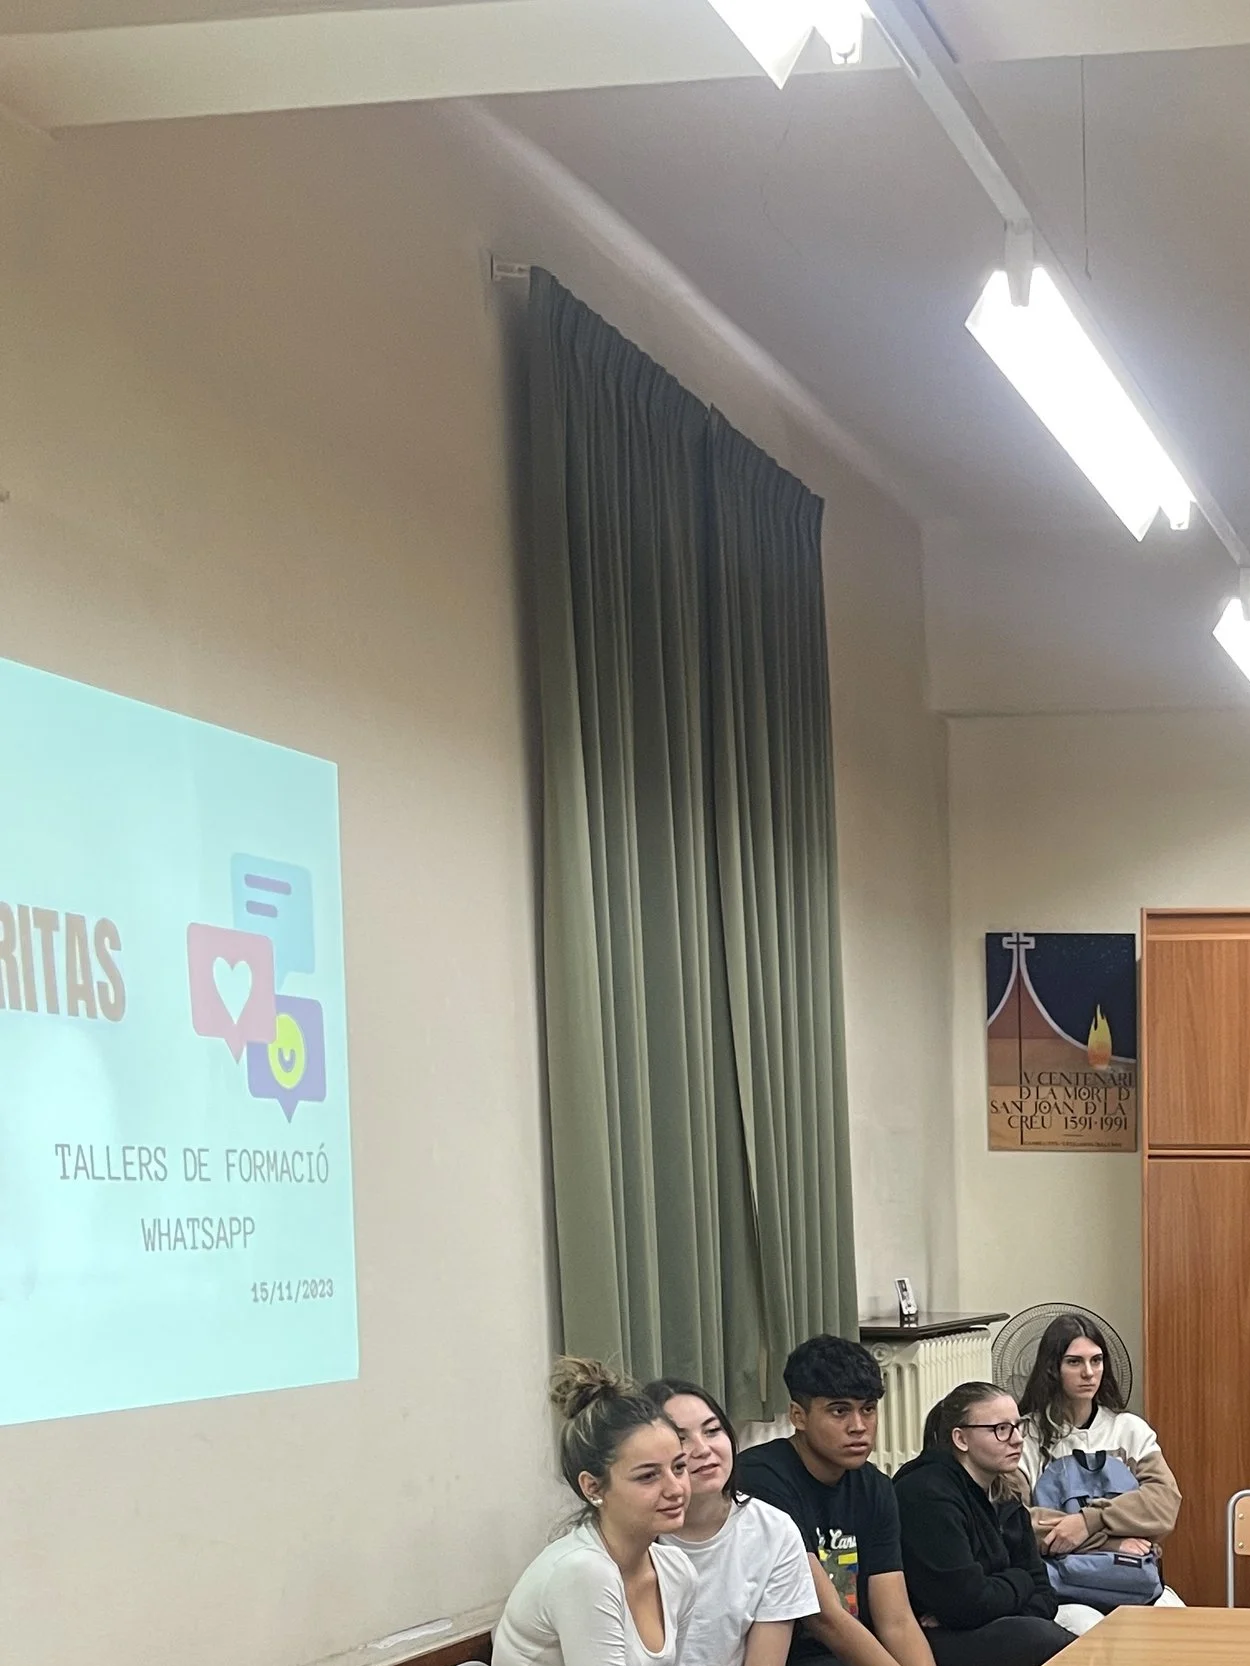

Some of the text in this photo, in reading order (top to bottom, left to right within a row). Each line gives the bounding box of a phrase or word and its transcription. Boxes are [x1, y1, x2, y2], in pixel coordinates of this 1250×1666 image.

[0, 901, 126, 1022] RITAS
[1037, 1071, 1132, 1087] CENTENARI
[1036, 1086, 1057, 1100] LA
[1064, 1086, 1109, 1102] MORT
[1032, 1100, 1074, 1117] JOAN
[1103, 1102, 1126, 1116] LA
[1007, 1115, 1052, 1131] CREU
[54, 1143, 329, 1183] TALLERS DE FORMACIÓ
[140, 1216, 256, 1252] WHATSAPP
[251, 1278, 334, 1305] 15/11/2023
